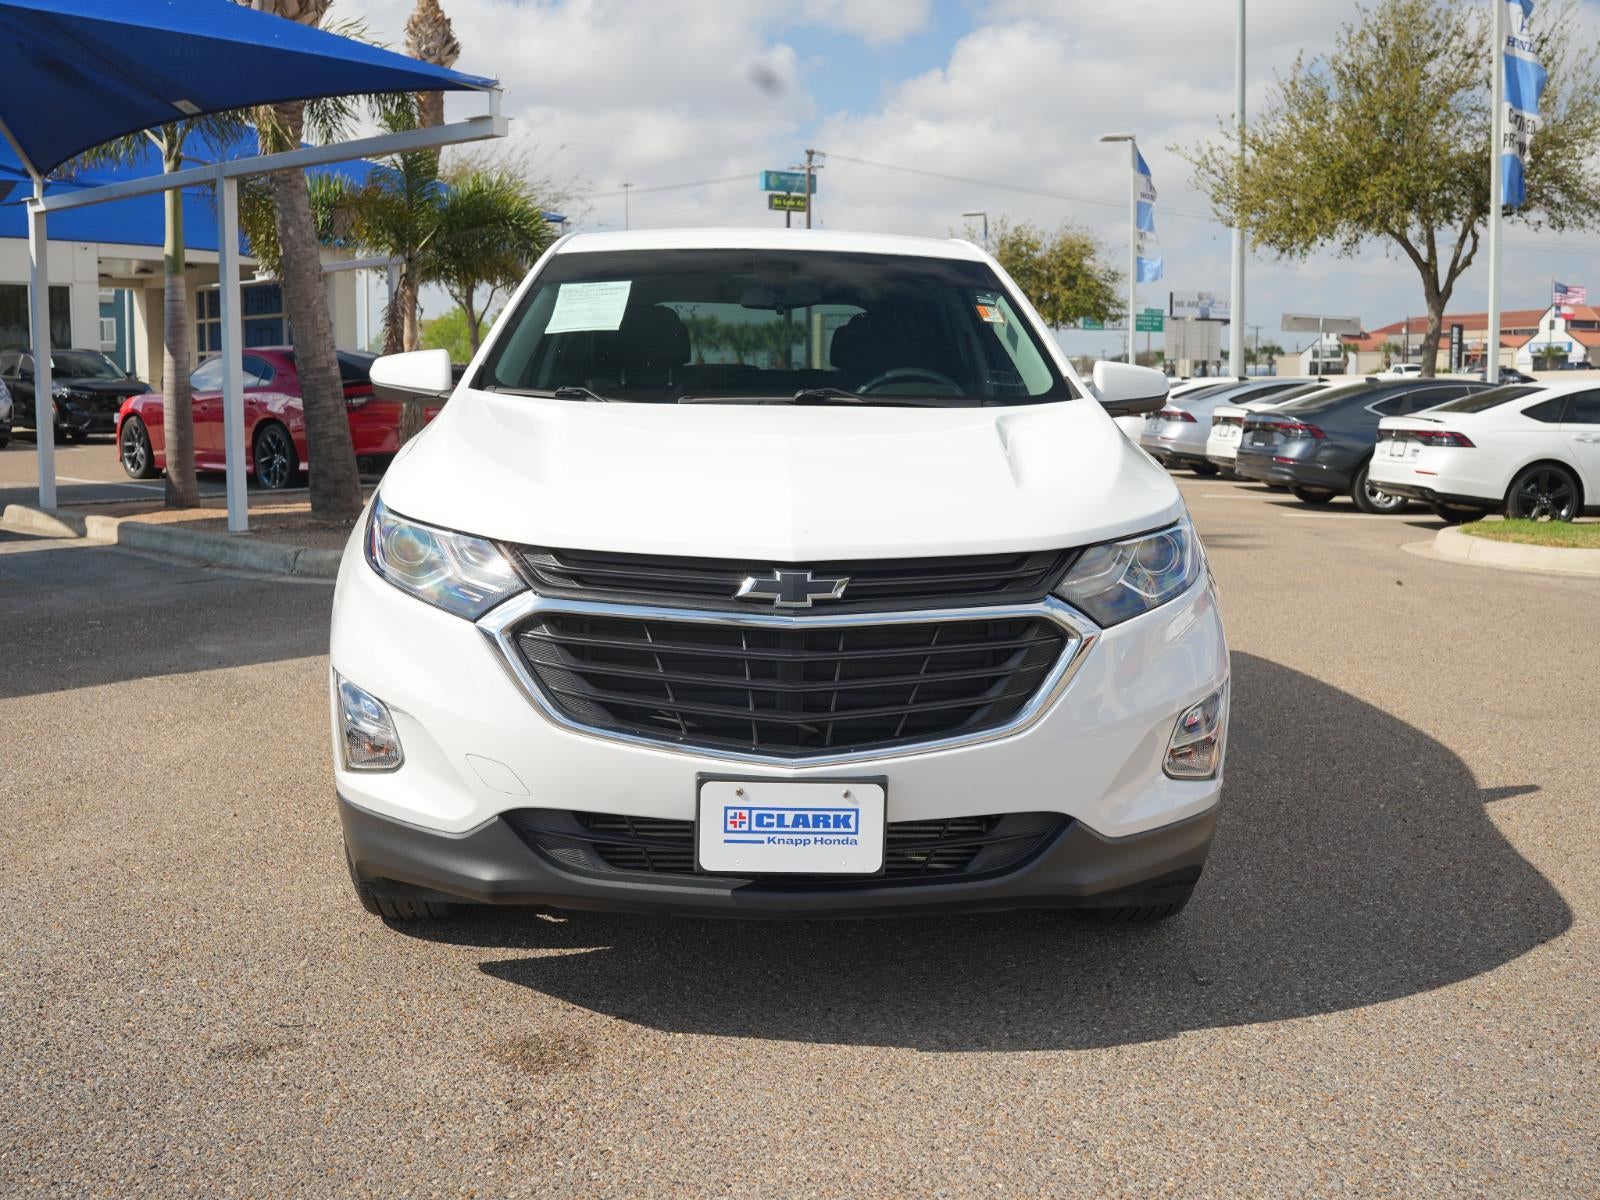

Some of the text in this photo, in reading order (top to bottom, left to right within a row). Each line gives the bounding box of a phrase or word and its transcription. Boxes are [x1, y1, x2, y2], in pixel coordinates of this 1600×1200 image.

[755, 813, 852, 829] CLARK
[767, 836, 858, 847] Knapp Honda
